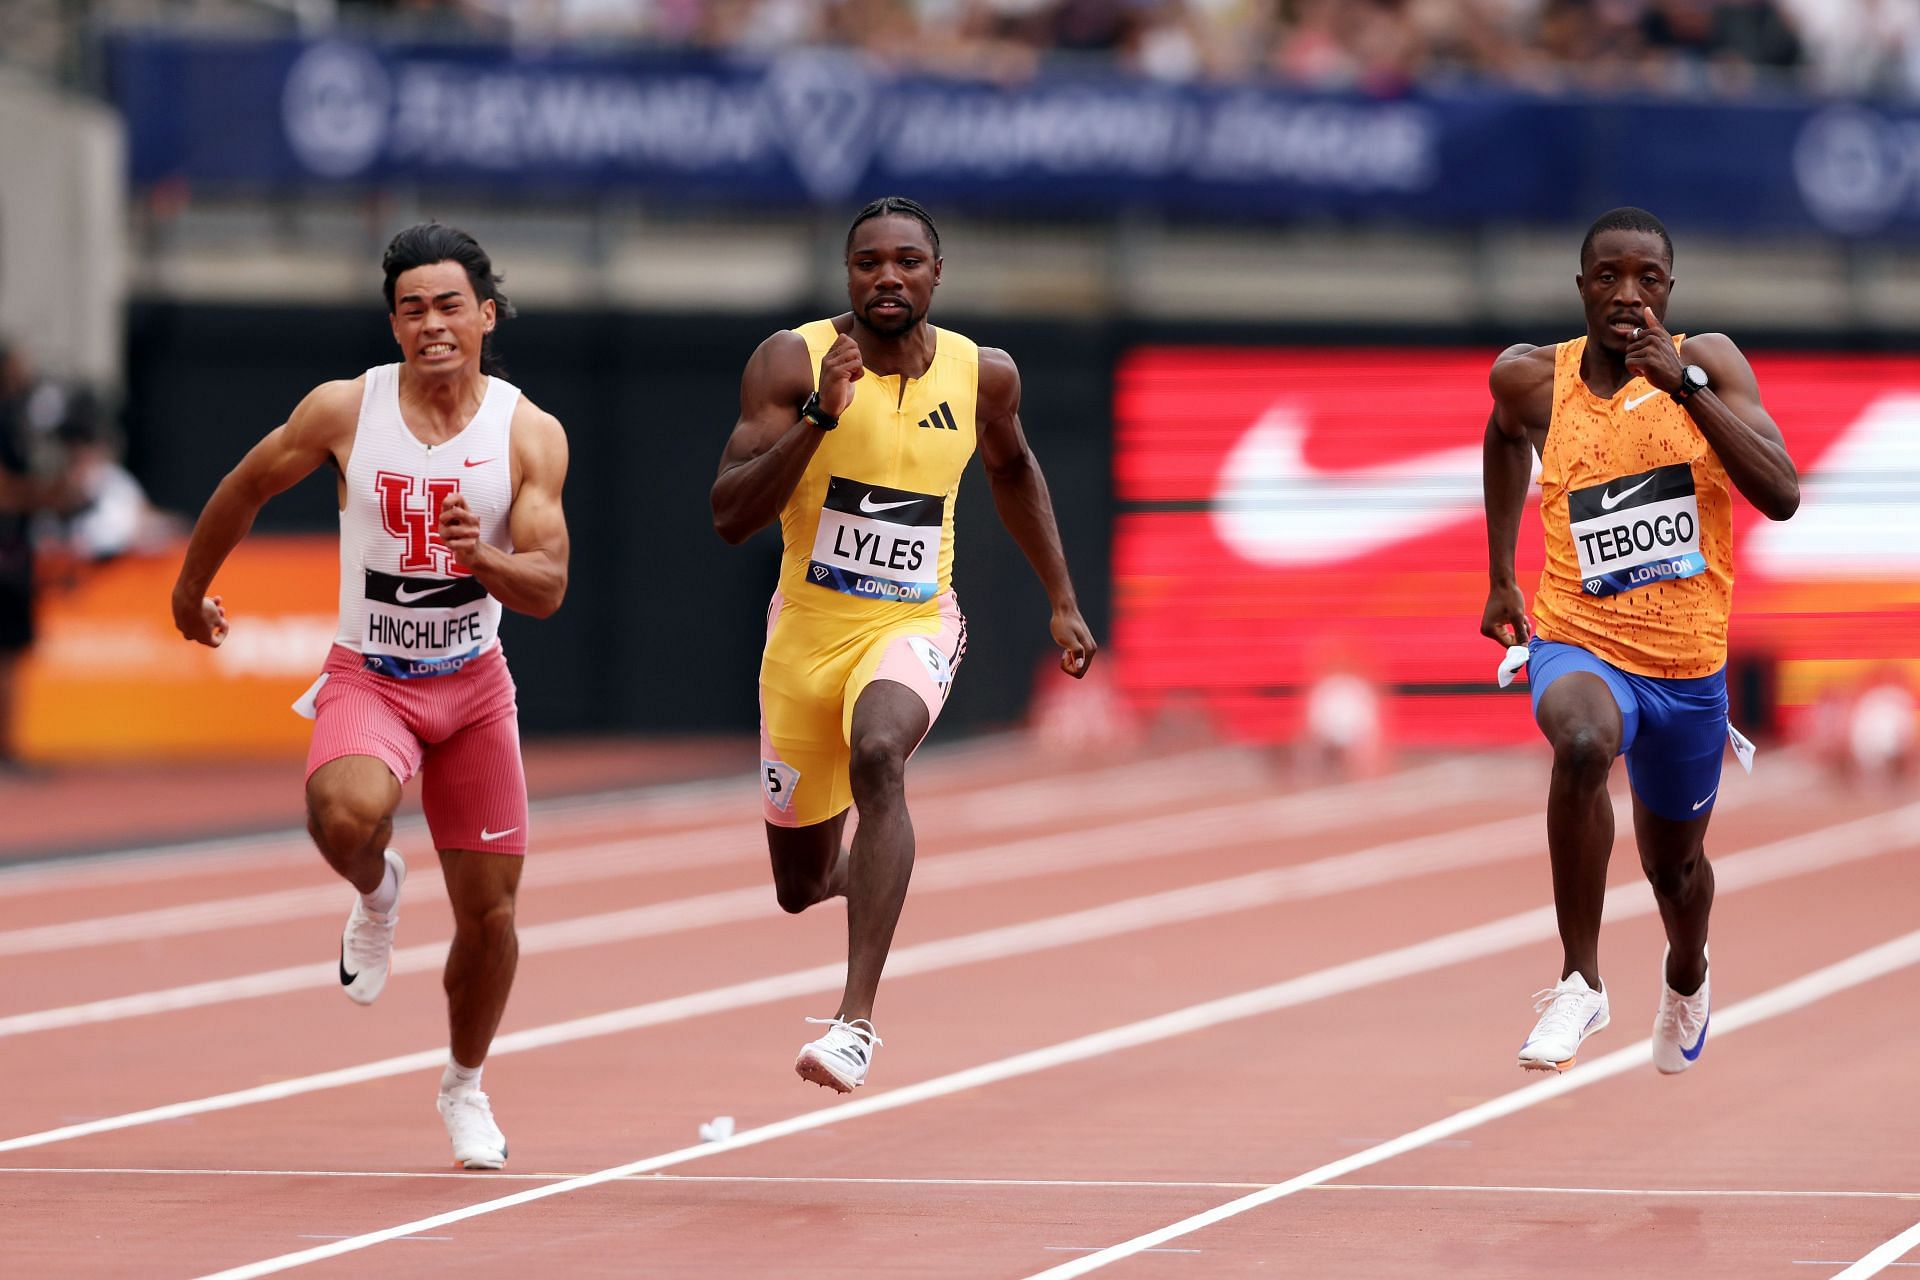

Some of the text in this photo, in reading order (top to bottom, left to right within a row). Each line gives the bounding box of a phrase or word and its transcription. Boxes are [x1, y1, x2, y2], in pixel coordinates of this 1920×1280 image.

[833, 524, 925, 571] LYLES
[1579, 511, 1694, 565] TEBOGO
[1629, 558, 1693, 584] LONDON
[855, 578, 921, 600] LONDON
[369, 611, 482, 649] HINCHLIFFE
[409, 657, 471, 674] LONDO
[929, 647, 939, 671] 5
[767, 768, 782, 793] 5
